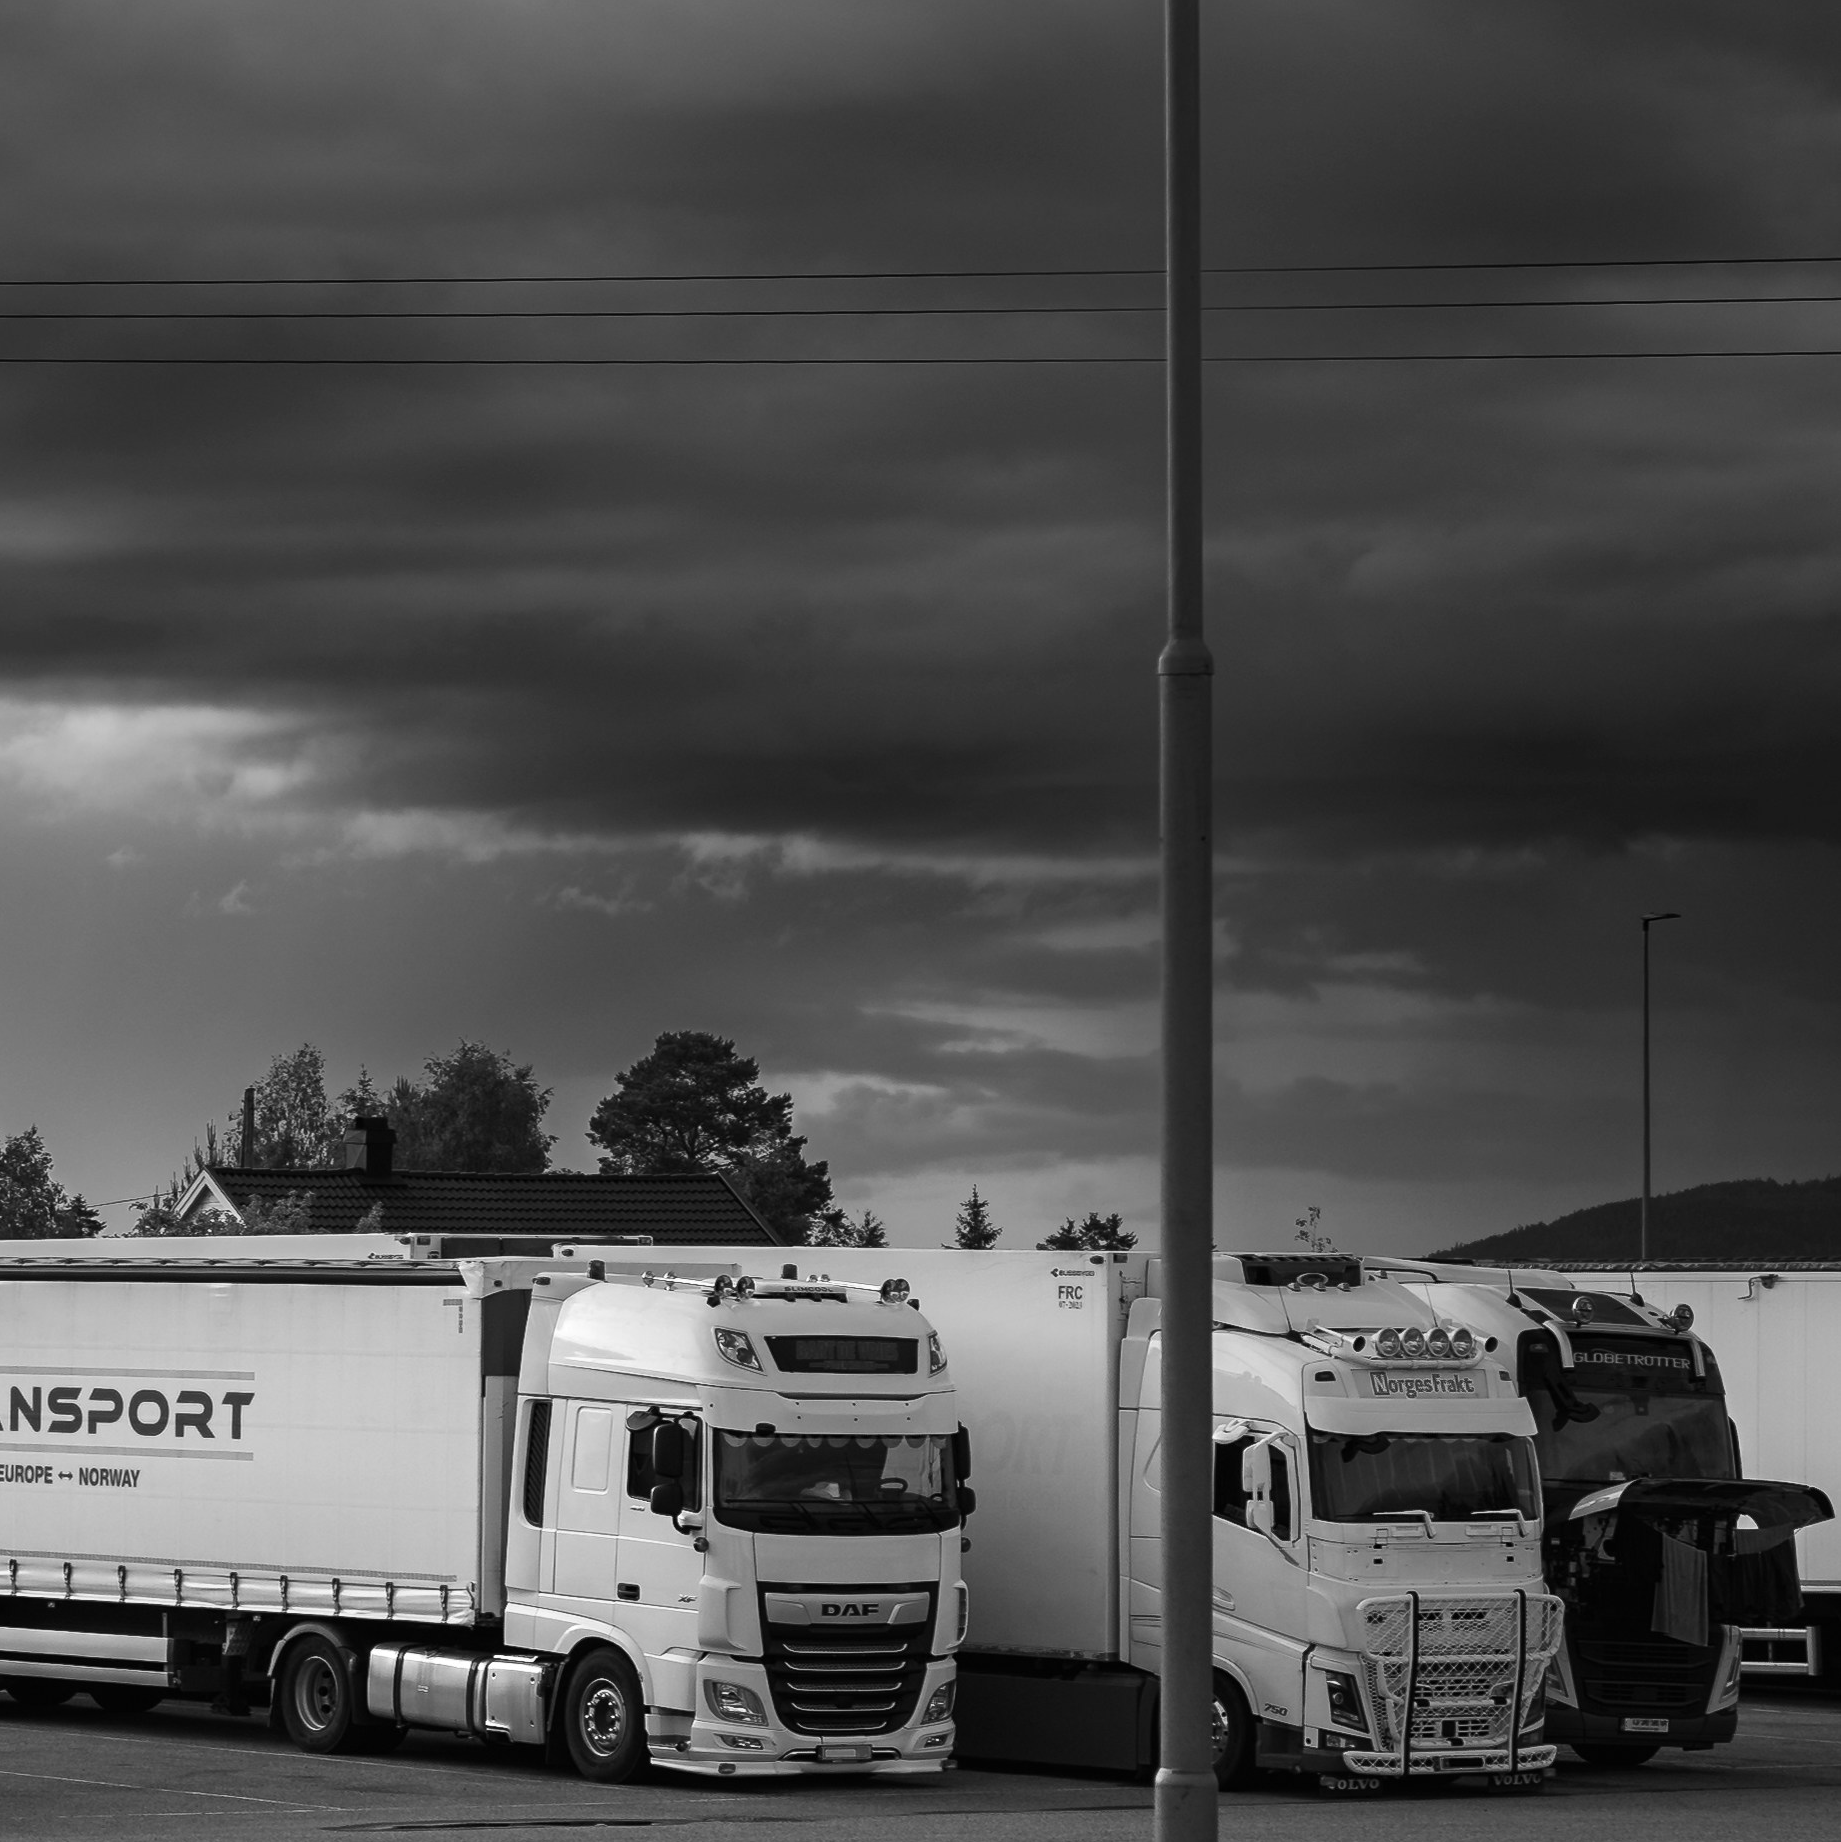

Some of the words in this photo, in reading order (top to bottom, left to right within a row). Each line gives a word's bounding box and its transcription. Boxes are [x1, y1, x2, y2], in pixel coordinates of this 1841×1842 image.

[1058, 1285, 1083, 1300] FRC
[1573, 1352, 1690, 1369] GLOBETROTTER
[78, 1466, 142, 1488] NORWAY
[821, 1603, 879, 1616] DAF
[1264, 1702, 1289, 1717] 750
[1493, 1773, 1542, 1786] VOLVO
